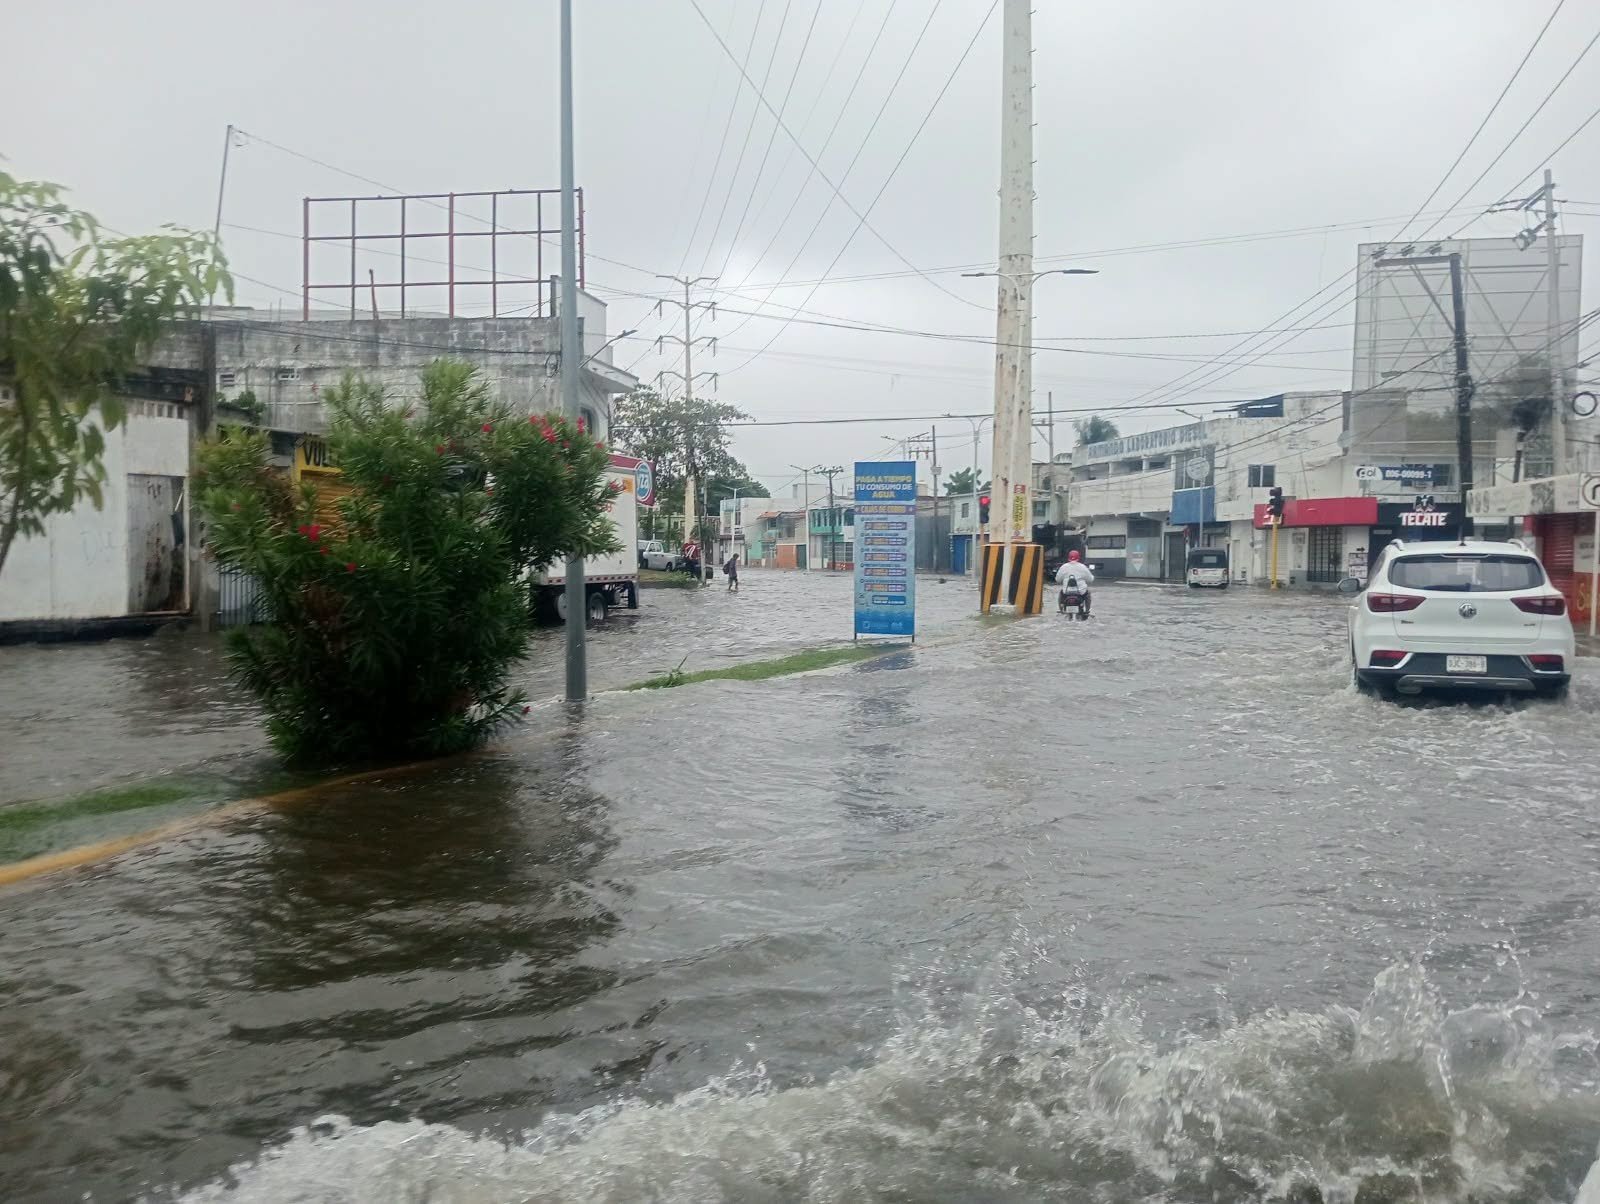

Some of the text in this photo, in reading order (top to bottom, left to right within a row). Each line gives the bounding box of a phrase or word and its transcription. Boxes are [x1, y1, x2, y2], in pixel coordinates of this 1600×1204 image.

[1126, 428, 1176, 453] LABORATORIO
[1179, 421, 1208, 443] DIESEL
[855, 483, 913, 491] TU CONSUMO DE
[1399, 511, 1451, 526] TECATE
